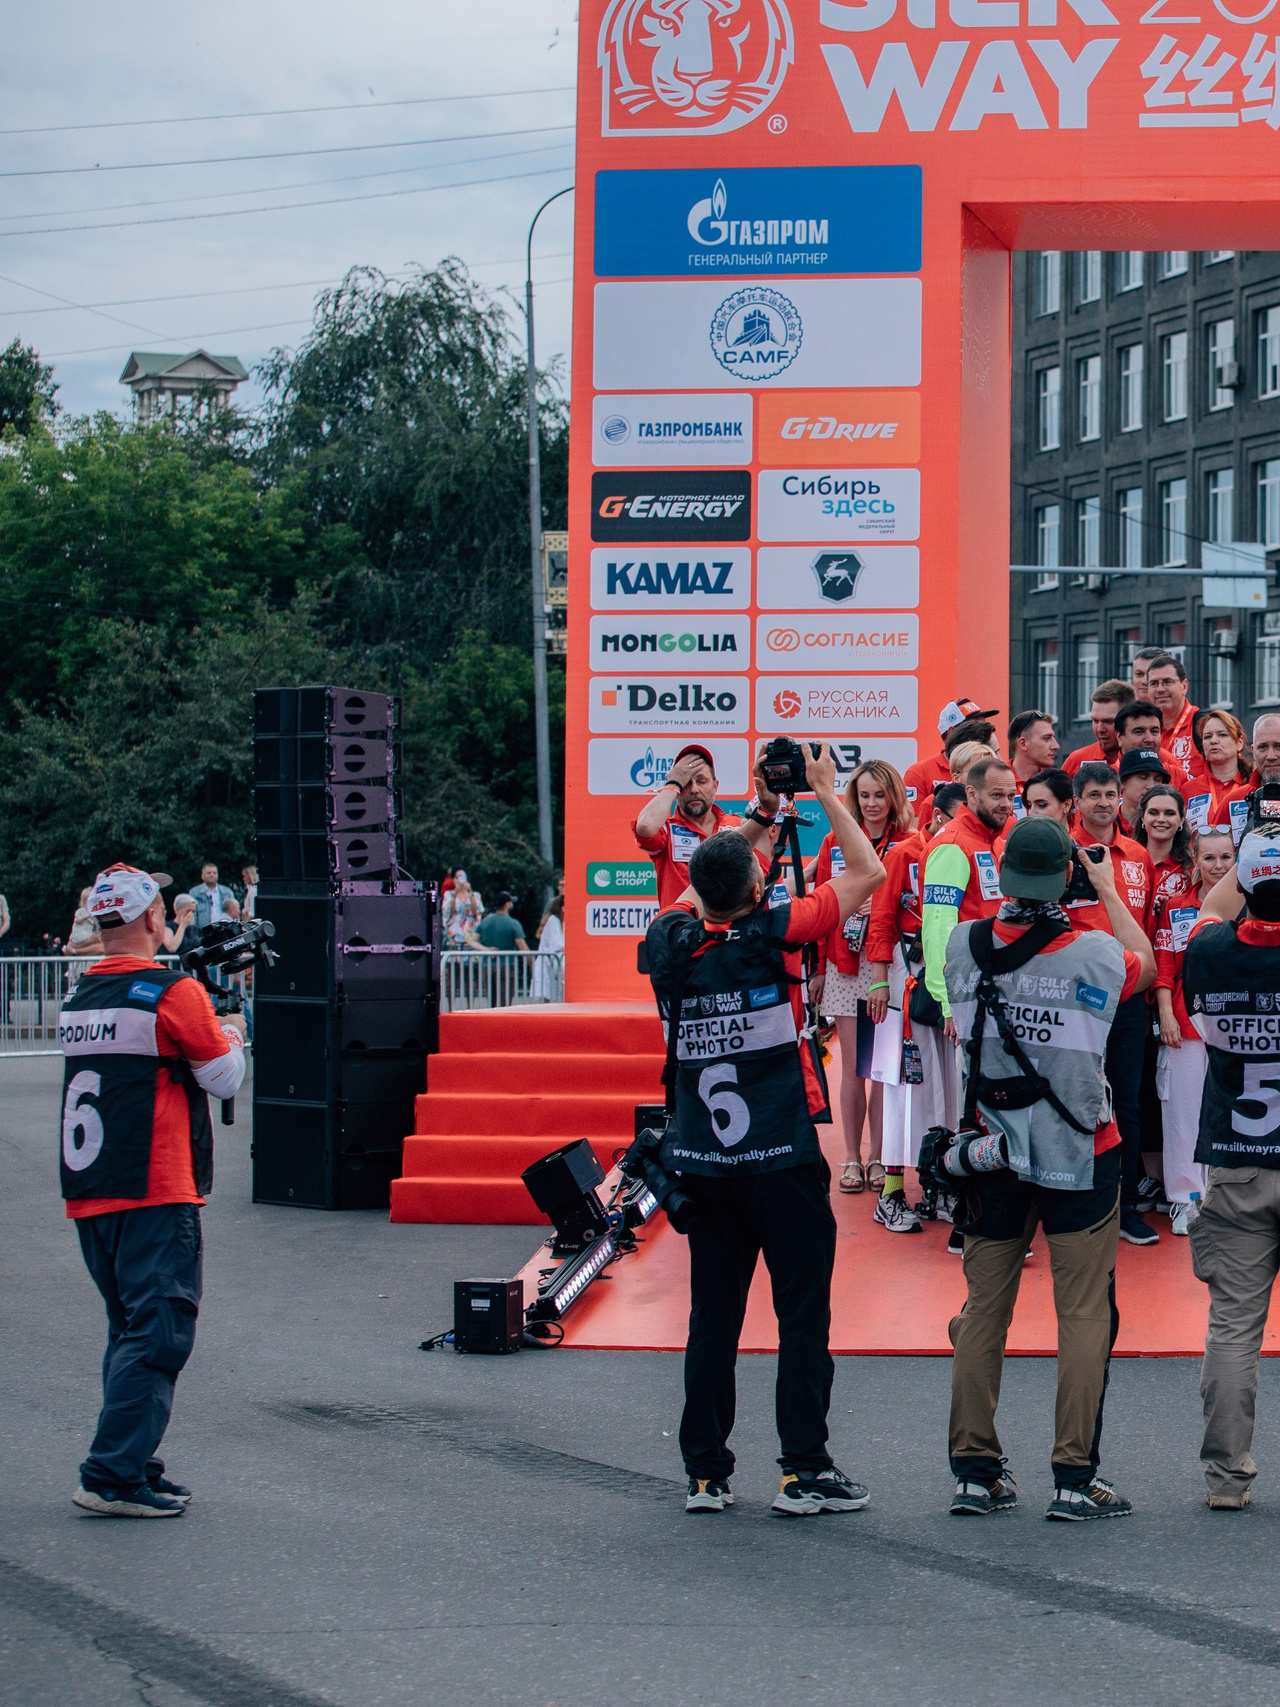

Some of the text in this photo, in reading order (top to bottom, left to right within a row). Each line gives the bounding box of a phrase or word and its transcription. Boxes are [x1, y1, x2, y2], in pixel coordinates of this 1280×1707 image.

[820, 38, 1120, 133] WAY
[728, 219, 829, 246] ГАЗПРОМ
[688, 252, 828, 266] ГЕНЕРАЛЬНЫЙ ПАРТНЕР
[723, 351, 790, 364] CAMF
[638, 422, 743, 437] ГАЗПРОМБАНК
[783, 476, 881, 502] Сибирь
[822, 499, 895, 517] здесь
[606, 562, 733, 595] KAMAZ
[602, 633, 737, 652] MONGOLIA
[804, 632, 909, 647] СОГЛАСИЕ
[627, 685, 737, 712] Delko
[808, 690, 888, 703] РУССКАЯ
[808, 706, 900, 719] МЕХАНИКА
[933, 886, 958, 896] SILK
[933, 895, 956, 904] WAY
[223, 937, 245, 951] RONIN
[1039, 976, 1070, 990] SILK
[715, 991, 742, 1002] SILK
[1038, 987, 1069, 1000] WAY
[1205, 991, 1249, 1002] МОСКОВСКИЙ
[716, 1001, 742, 1013] WAY
[1206, 1002, 1225, 1012] СПОРТ
[678, 1017, 754, 1039] OFFICIAL
[685, 1036, 744, 1056] PHOTO
[698, 1063, 750, 1148] 6
[63, 1070, 104, 1172] 6
